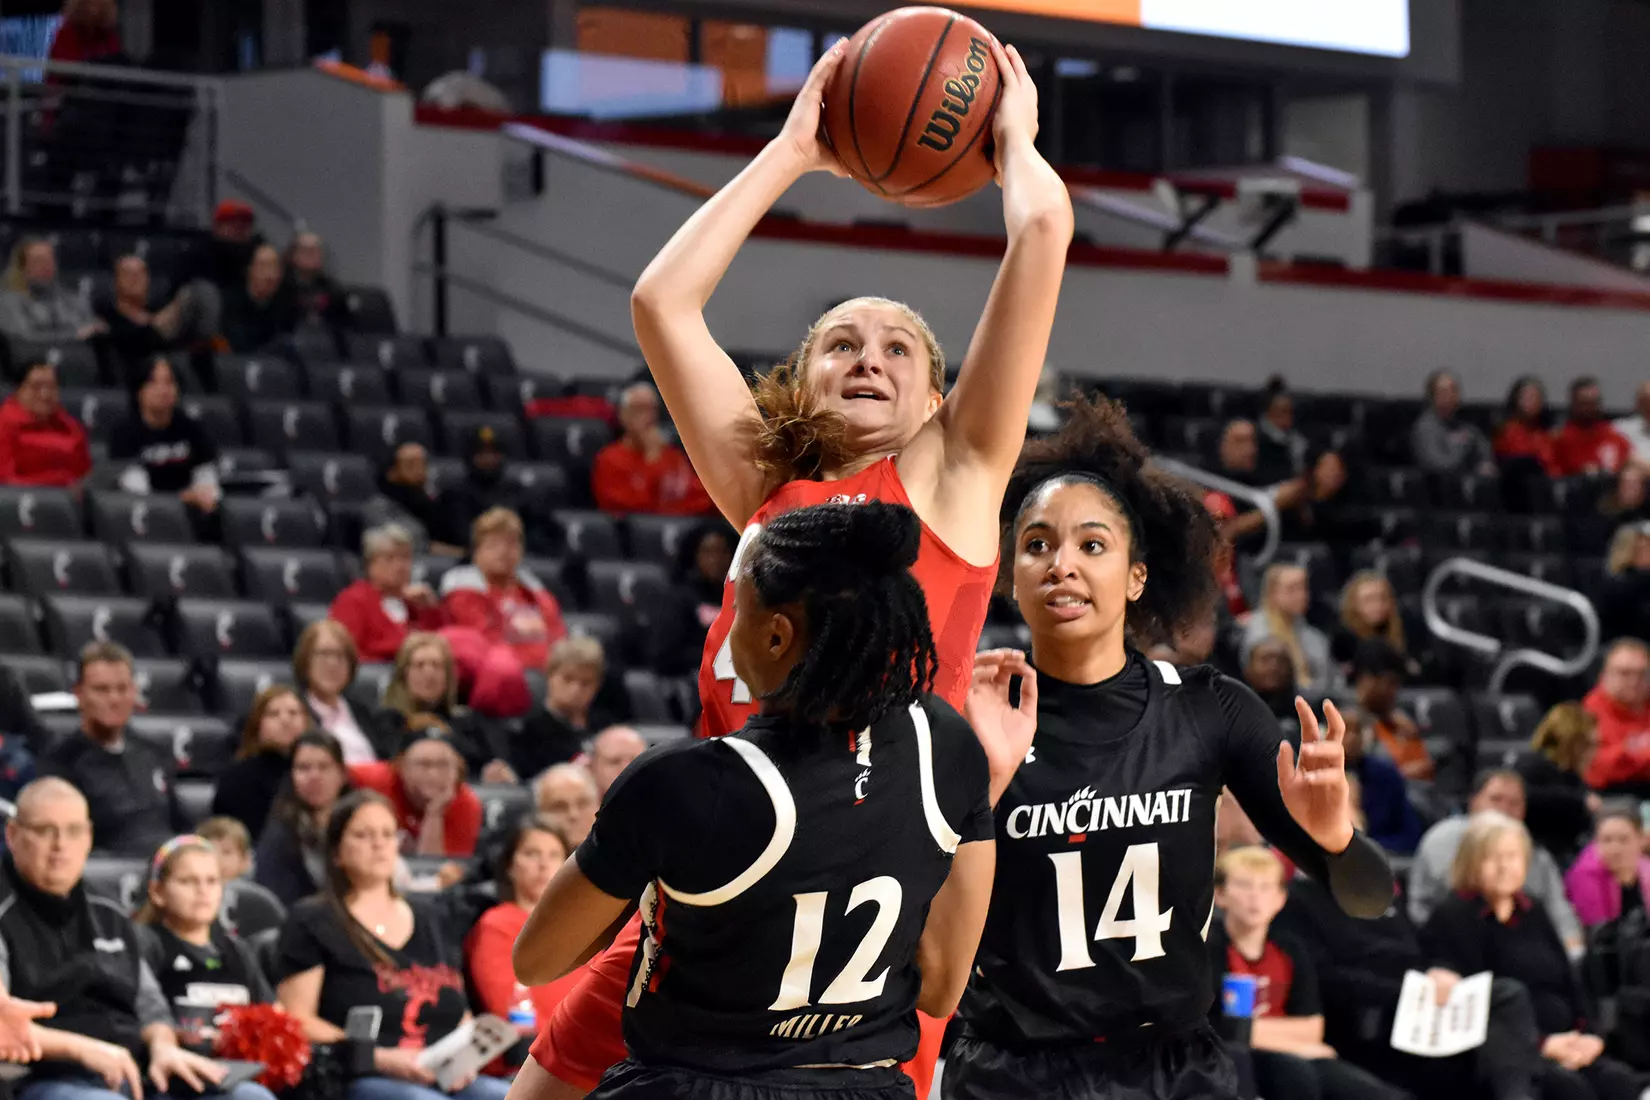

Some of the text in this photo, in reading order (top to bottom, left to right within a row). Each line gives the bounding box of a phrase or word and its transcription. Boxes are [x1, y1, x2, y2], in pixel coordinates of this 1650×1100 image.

[917, 36, 989, 151] Wilson
[1006, 786, 1193, 839] CINCINNATI
[767, 875, 903, 1011] 12
[1047, 842, 1174, 972] 14
